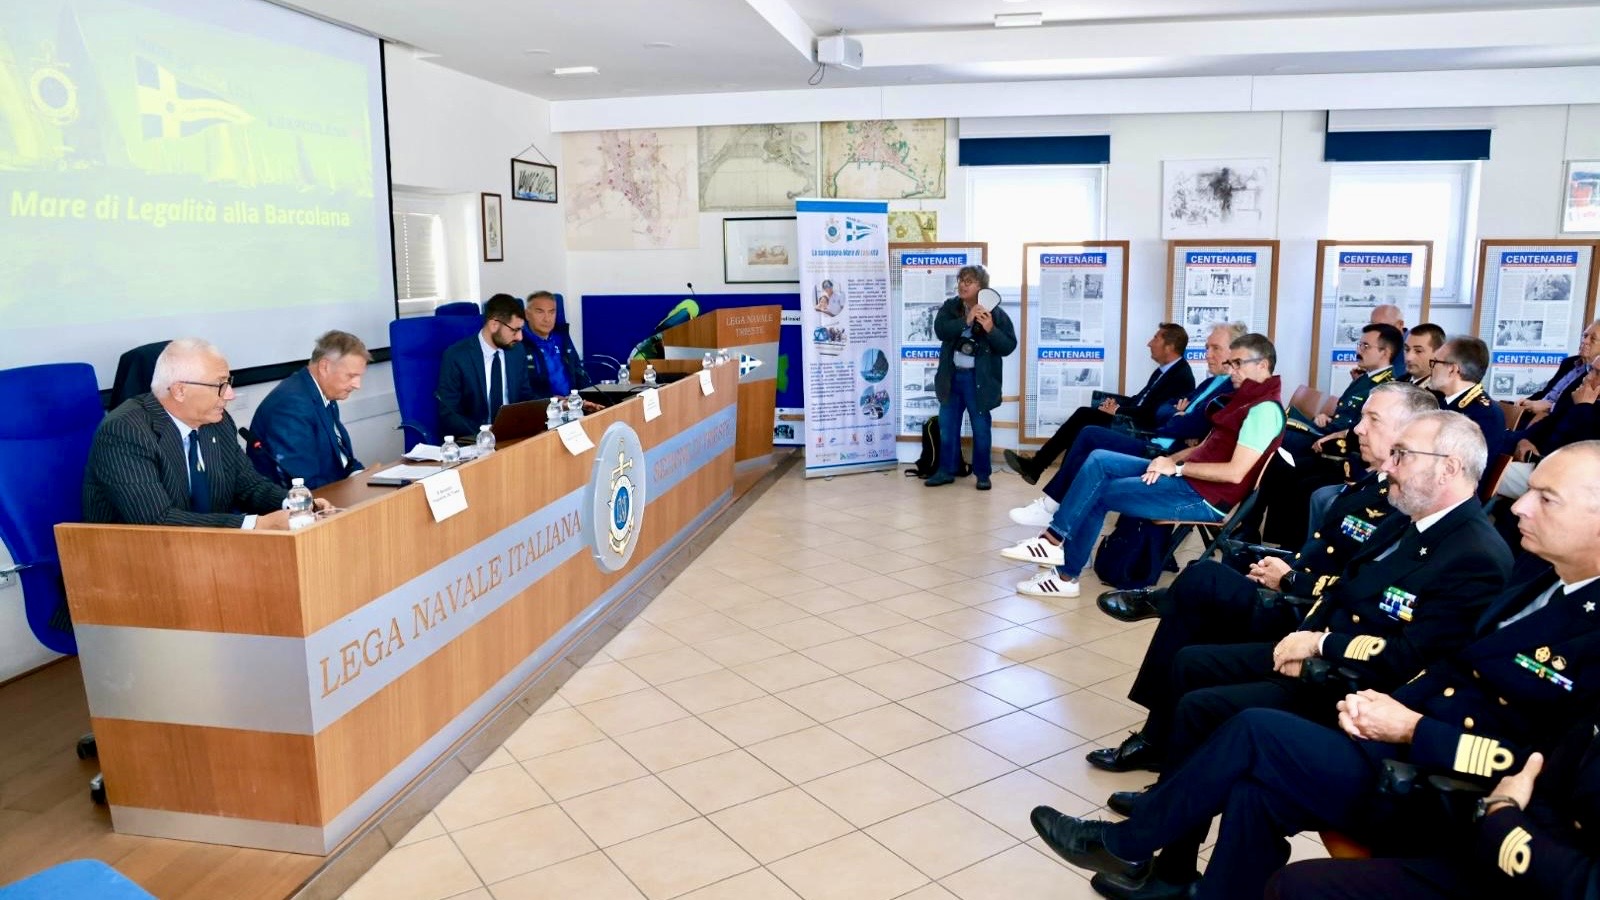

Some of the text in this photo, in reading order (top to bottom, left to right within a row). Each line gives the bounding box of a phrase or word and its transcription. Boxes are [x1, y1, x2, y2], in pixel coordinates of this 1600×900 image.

[10, 190, 86, 218] Mare
[95, 195, 120, 220] di
[223, 201, 260, 225] alla
[264, 203, 350, 228] Barcolana
[905, 256, 963, 265] CENTENARIE
[1043, 255, 1103, 264] CENTENARIE
[1190, 255, 1252, 264] CENTENARIE
[1343, 255, 1408, 264] CENTENARIE
[1506, 255, 1573, 264] CENTENARIE
[905, 350, 940, 359] CENTEN
[1042, 350, 1100, 359] CENTENARIE
[1497, 355, 1563, 364] CENTENARIE
[319, 508, 583, 699] LEGA NAVALE ITALIANA
